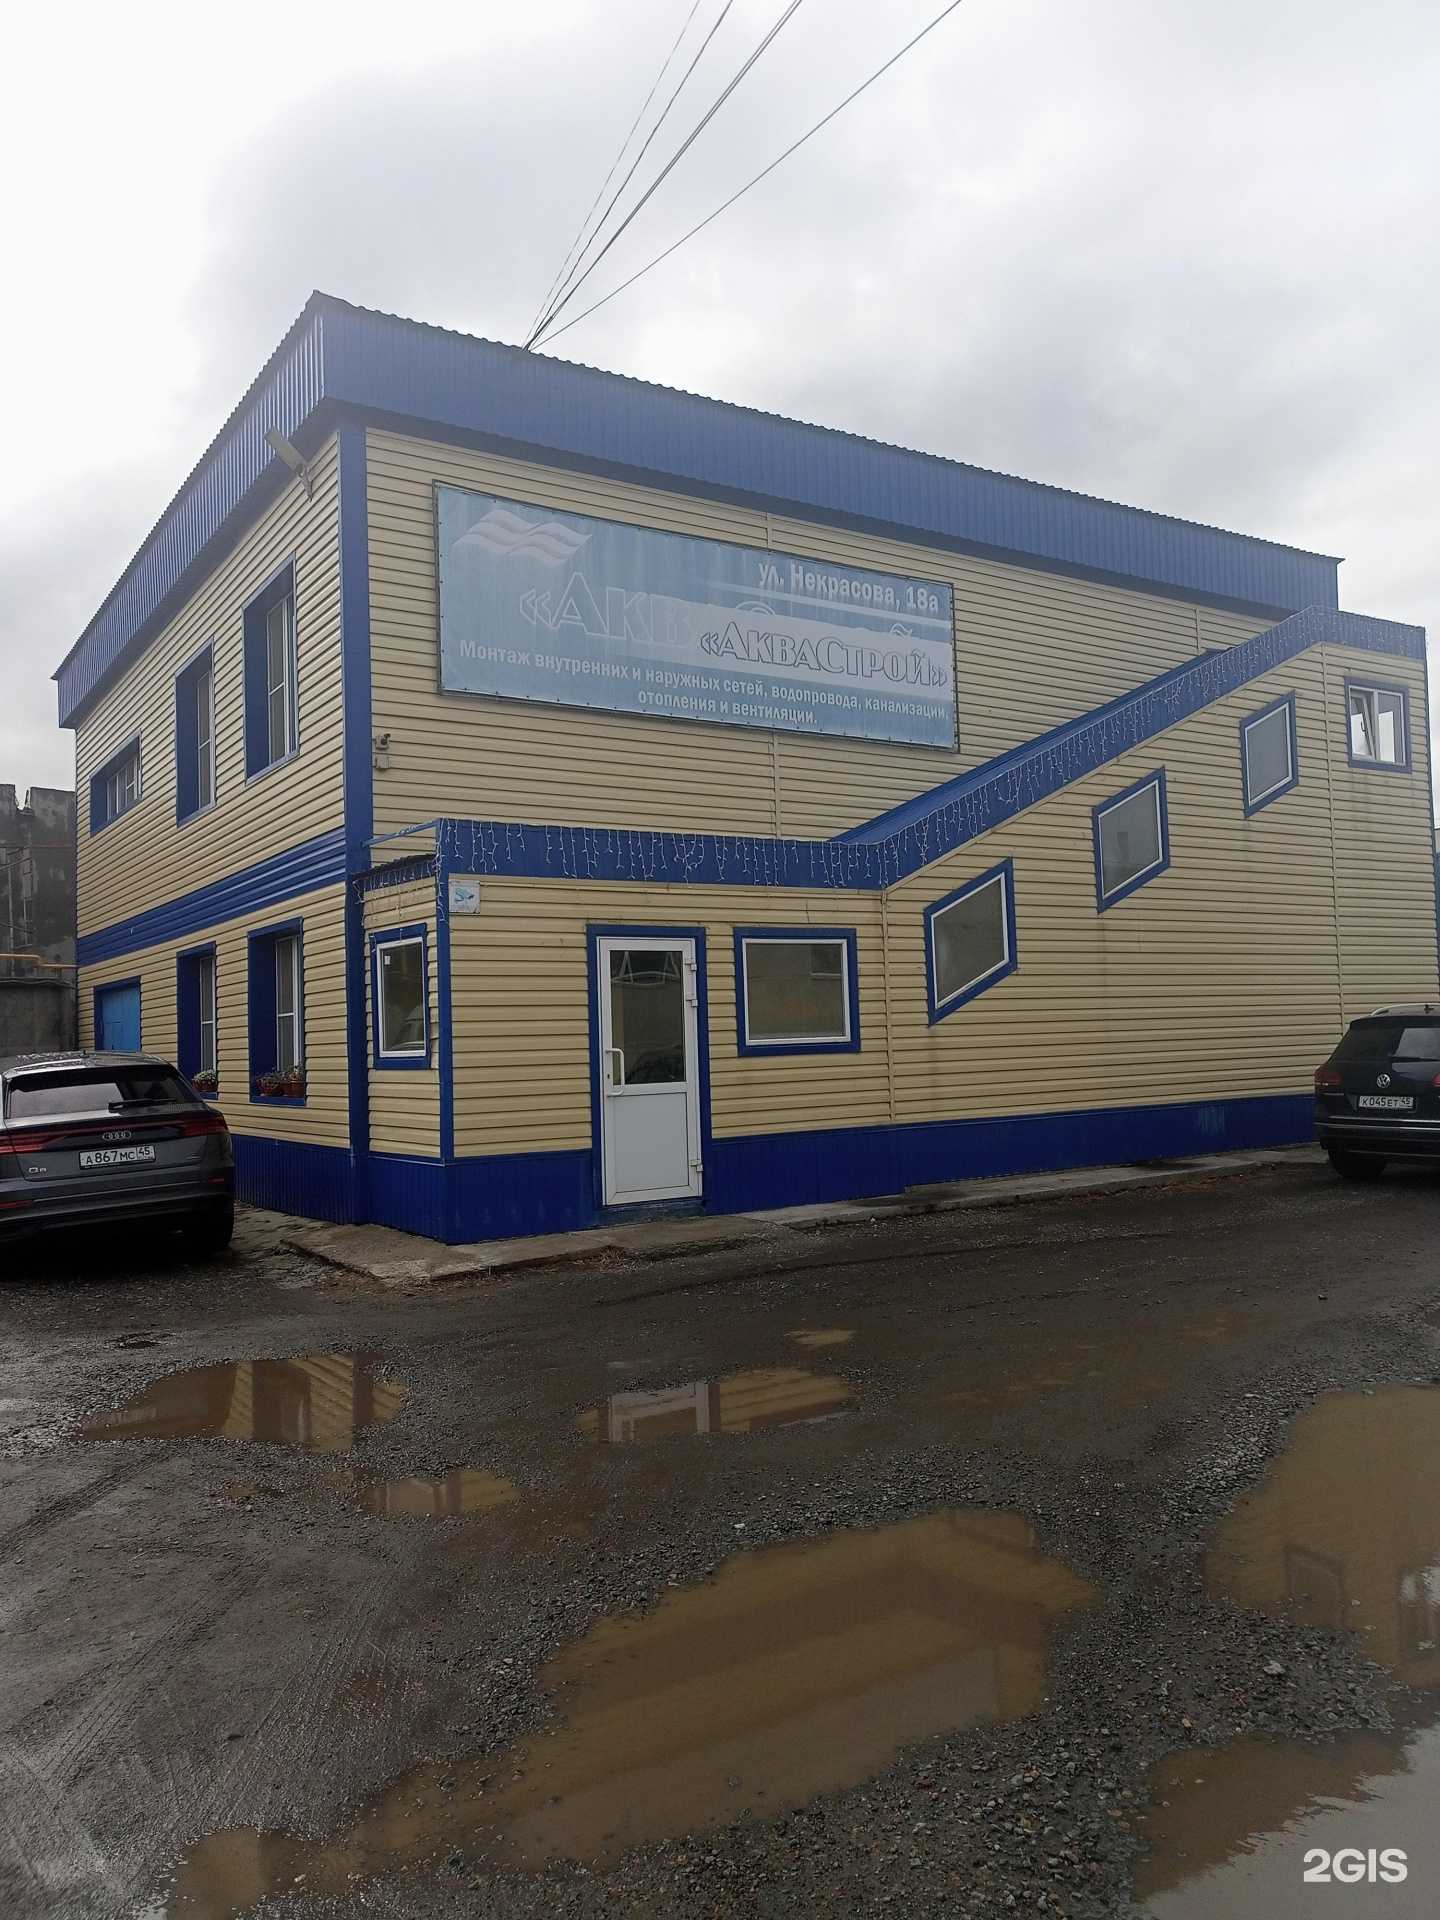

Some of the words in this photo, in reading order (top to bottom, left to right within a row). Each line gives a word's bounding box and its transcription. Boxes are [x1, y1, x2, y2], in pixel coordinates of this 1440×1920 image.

[758, 563, 785, 586] ул.
[790, 565, 901, 610] Некрасова,
[906, 586, 938, 612] 18а
[460, 639, 530, 667] Монтаж
[534, 653, 629, 679] внутренних
[632, 669, 641, 681] и
[645, 668, 720, 692] наружных
[723, 679, 768, 697] сетей,
[771, 684, 862, 710] водопровода,
[638, 690, 716, 712] отопления
[719, 700, 729, 714] и
[732, 702, 818, 724] вентиляции.
